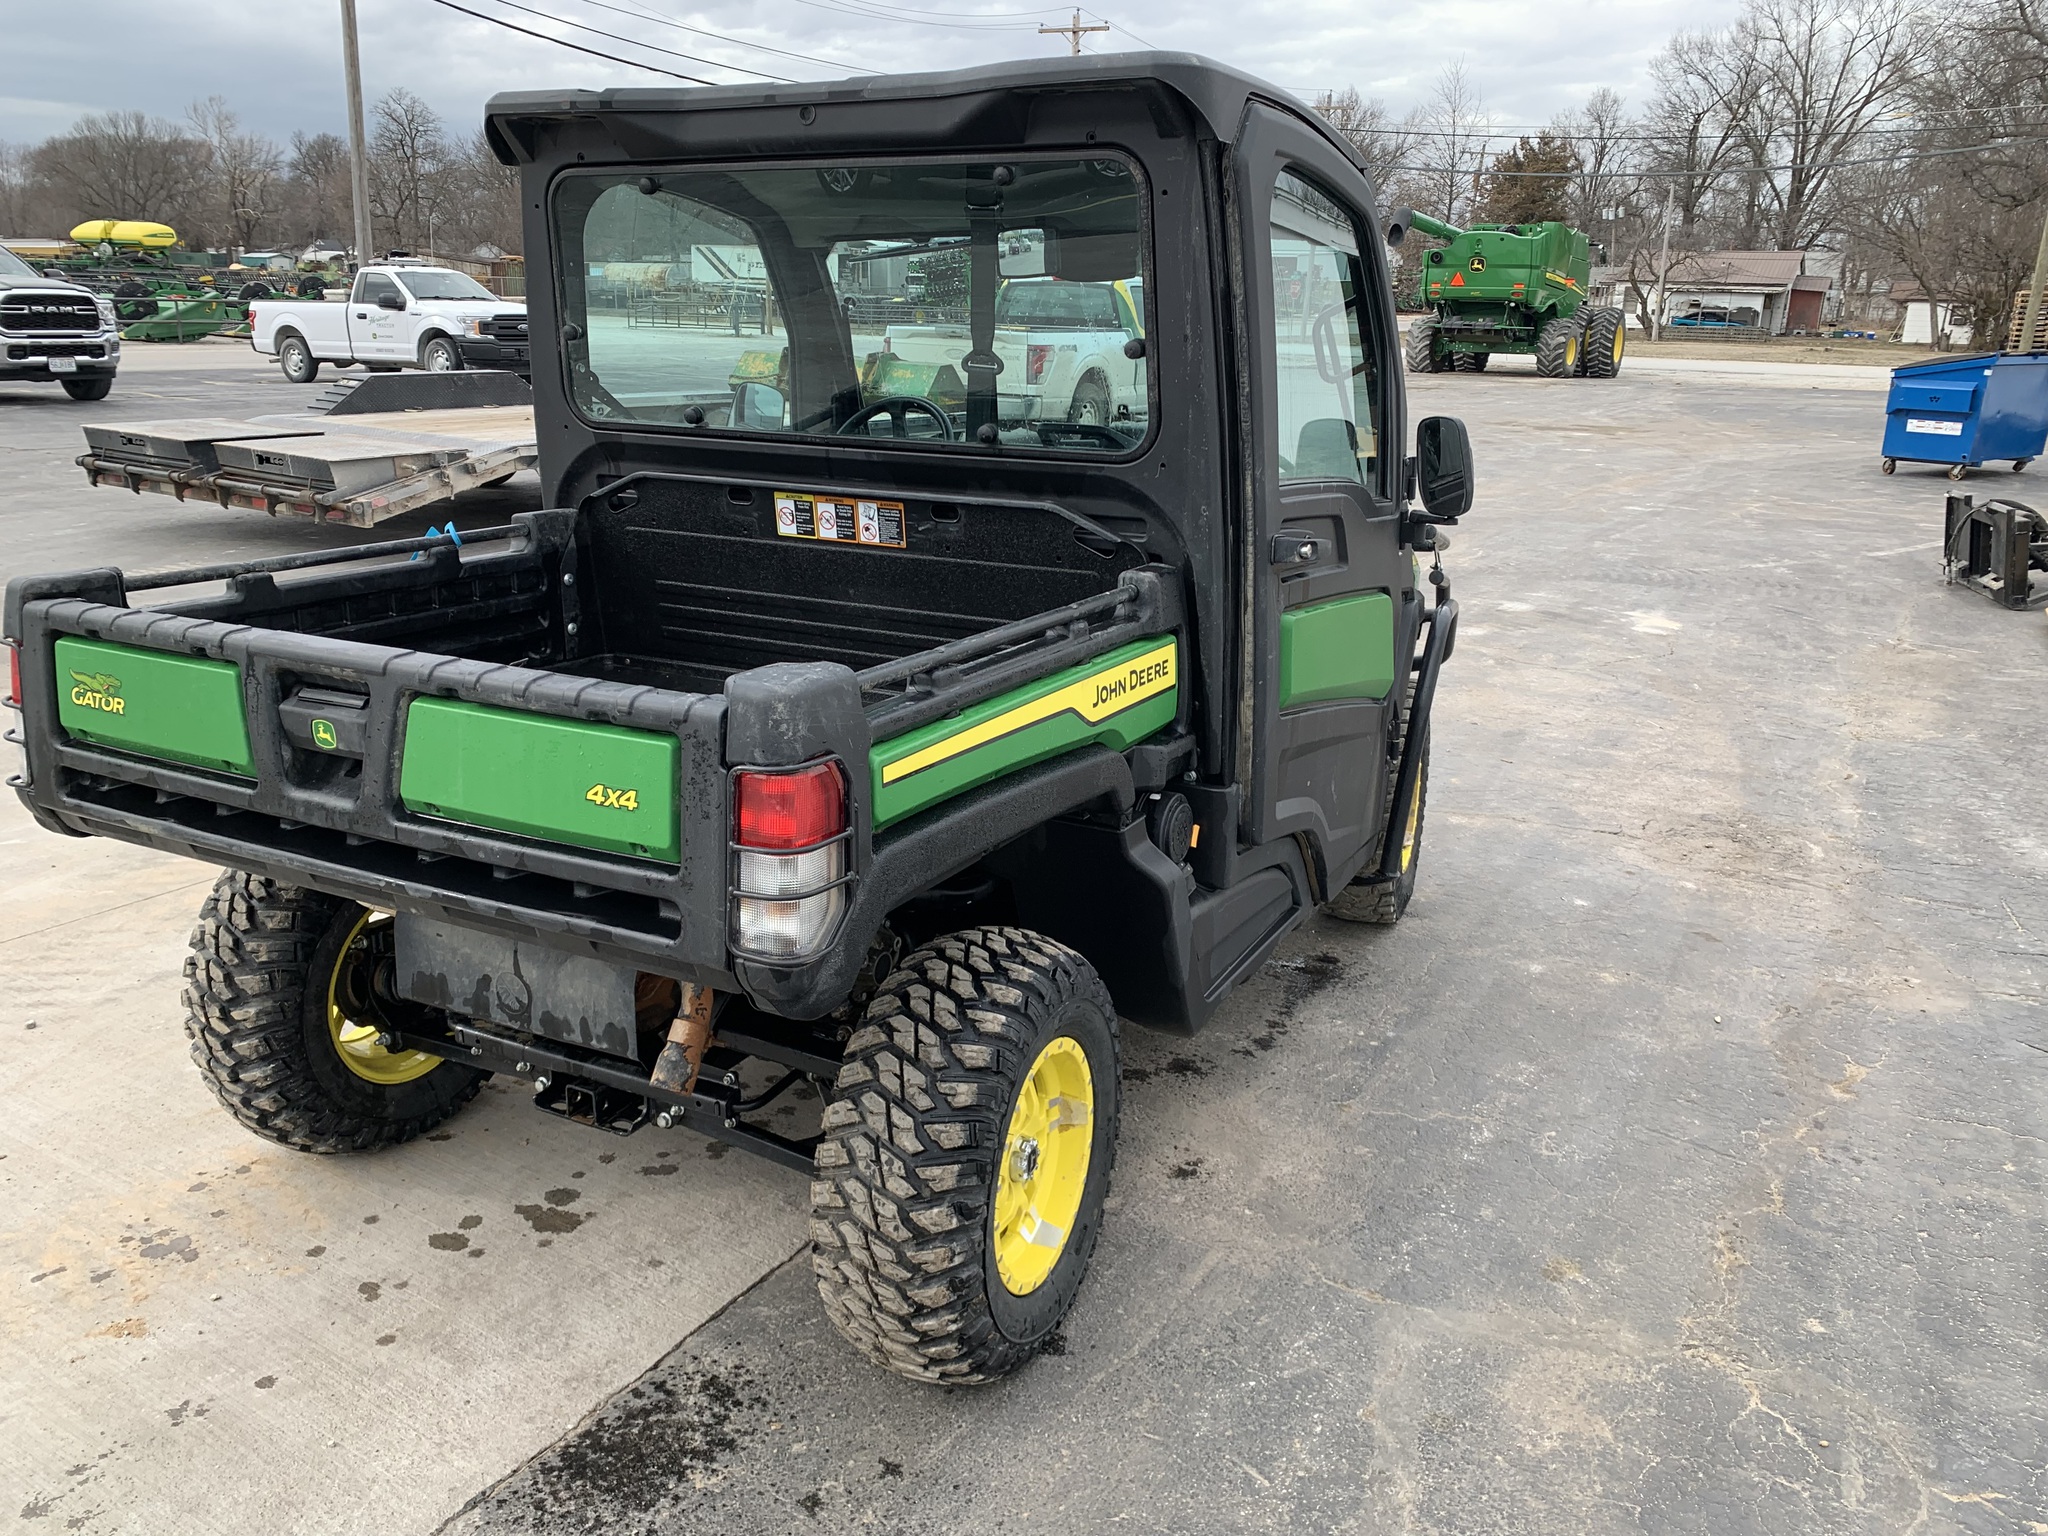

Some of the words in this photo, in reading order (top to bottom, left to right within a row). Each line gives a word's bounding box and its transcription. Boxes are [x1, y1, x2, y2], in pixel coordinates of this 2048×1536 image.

[71, 686, 126, 716] GATOR
[1092, 677, 1127, 708] JOHN
[1129, 659, 1169, 691] DEERE
